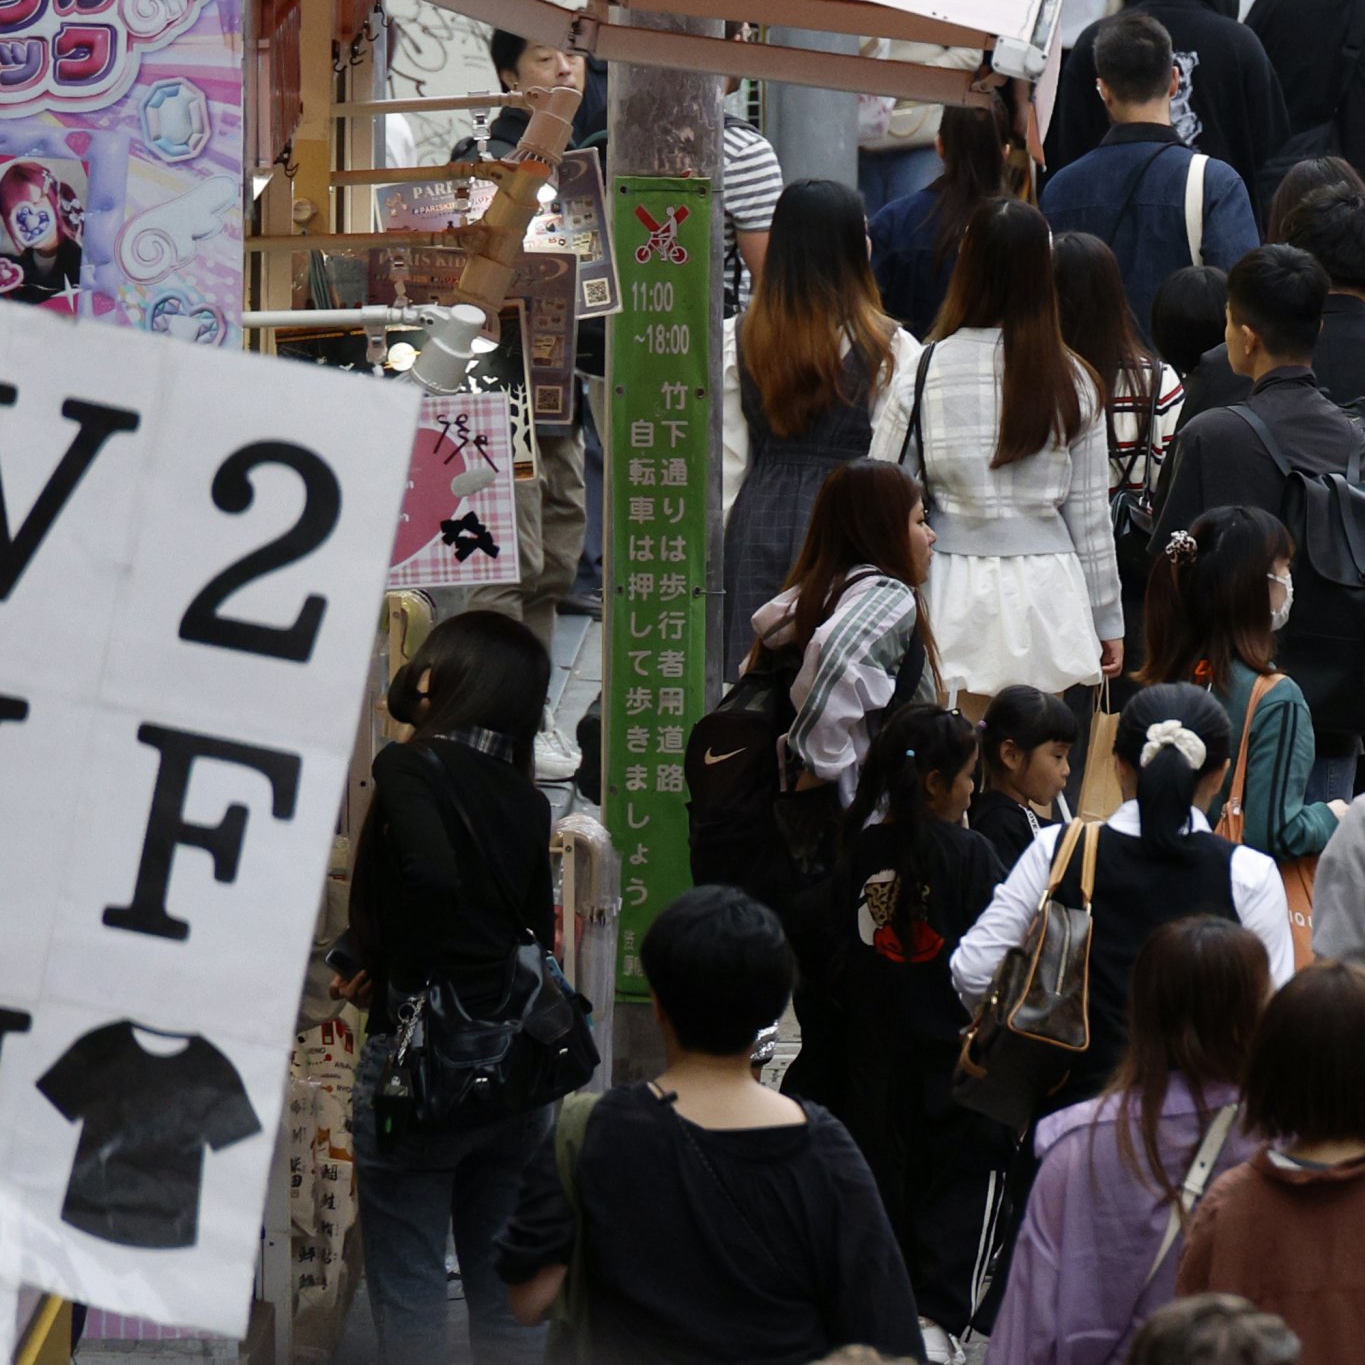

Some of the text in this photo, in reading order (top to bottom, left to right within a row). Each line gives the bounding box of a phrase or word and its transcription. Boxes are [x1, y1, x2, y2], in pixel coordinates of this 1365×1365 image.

[631, 281, 674, 313] 11:00
[625, 418, 656, 907] 自転車は押して歩きましょう
[655, 380, 690, 794] 竹下通りは歩行者用道路
